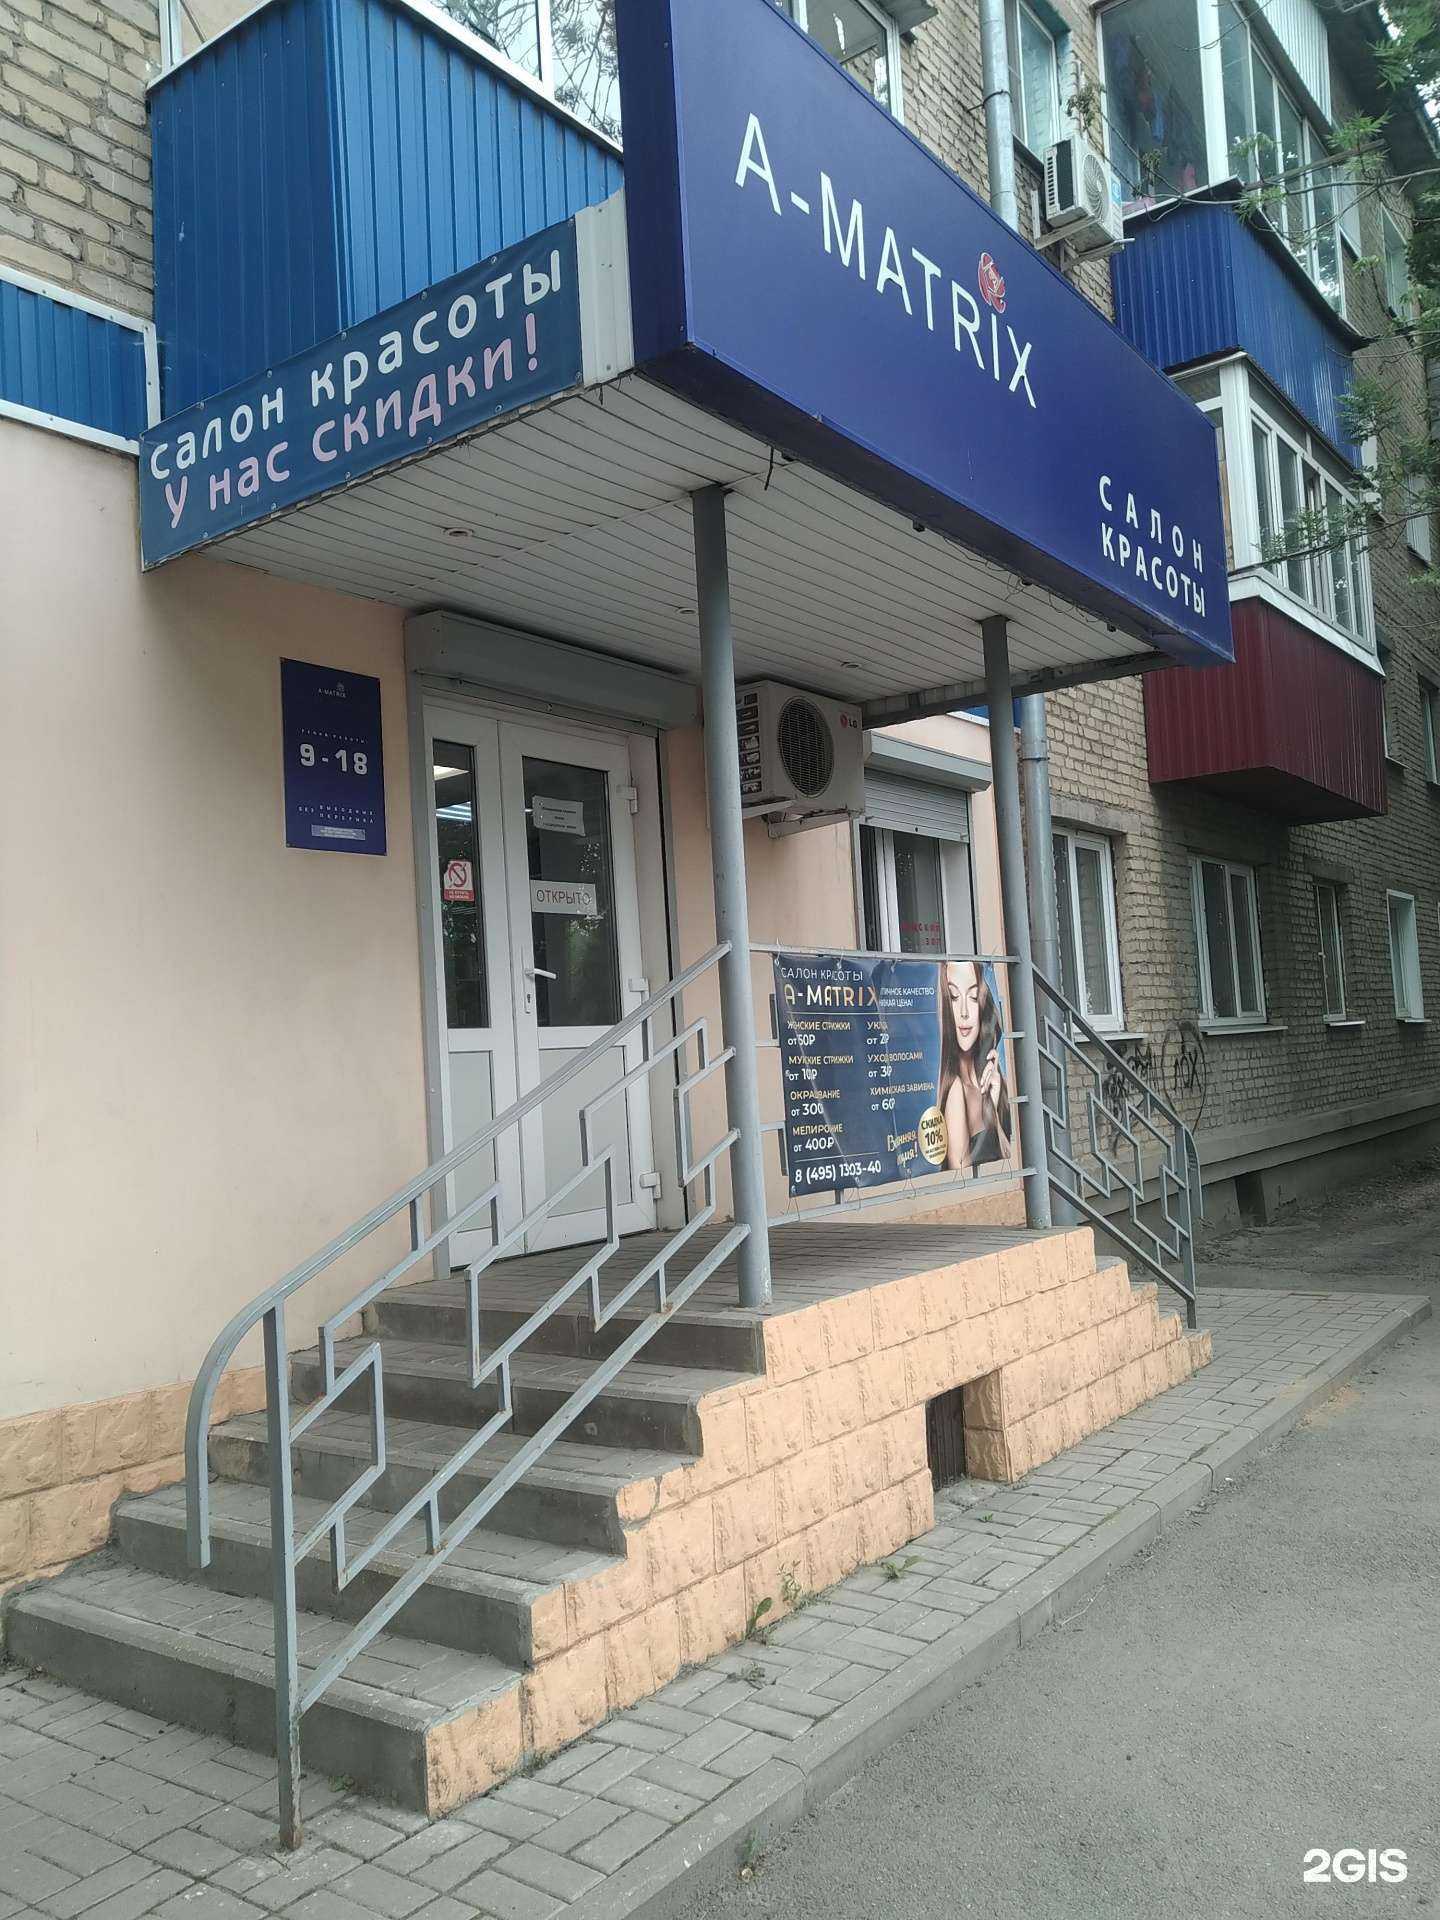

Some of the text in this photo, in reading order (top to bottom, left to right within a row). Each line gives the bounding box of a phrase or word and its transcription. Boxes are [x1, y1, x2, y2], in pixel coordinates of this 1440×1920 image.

[735, 112, 1037, 409] A-MATRIX
[150, 249, 562, 480] салон красоты
[208, 441, 290, 511] нас
[1098, 474, 1203, 573] САЛОН
[1101, 522, 1206, 618] КРАСОТЫ
[536, 888, 593, 906] ОТКРЫТО
[781, 967, 818, 979] САЛОН
[789, 1073, 799, 1081] от
[868, 1070, 878, 1078] от
[791, 1109, 800, 1117] от
[871, 1103, 879, 1111] от
[925, 1128, 944, 1147] 10%
[793, 1145, 802, 1153] от
[795, 1169, 802, 1183] 8
[806, 1164, 836, 1184] (495)
